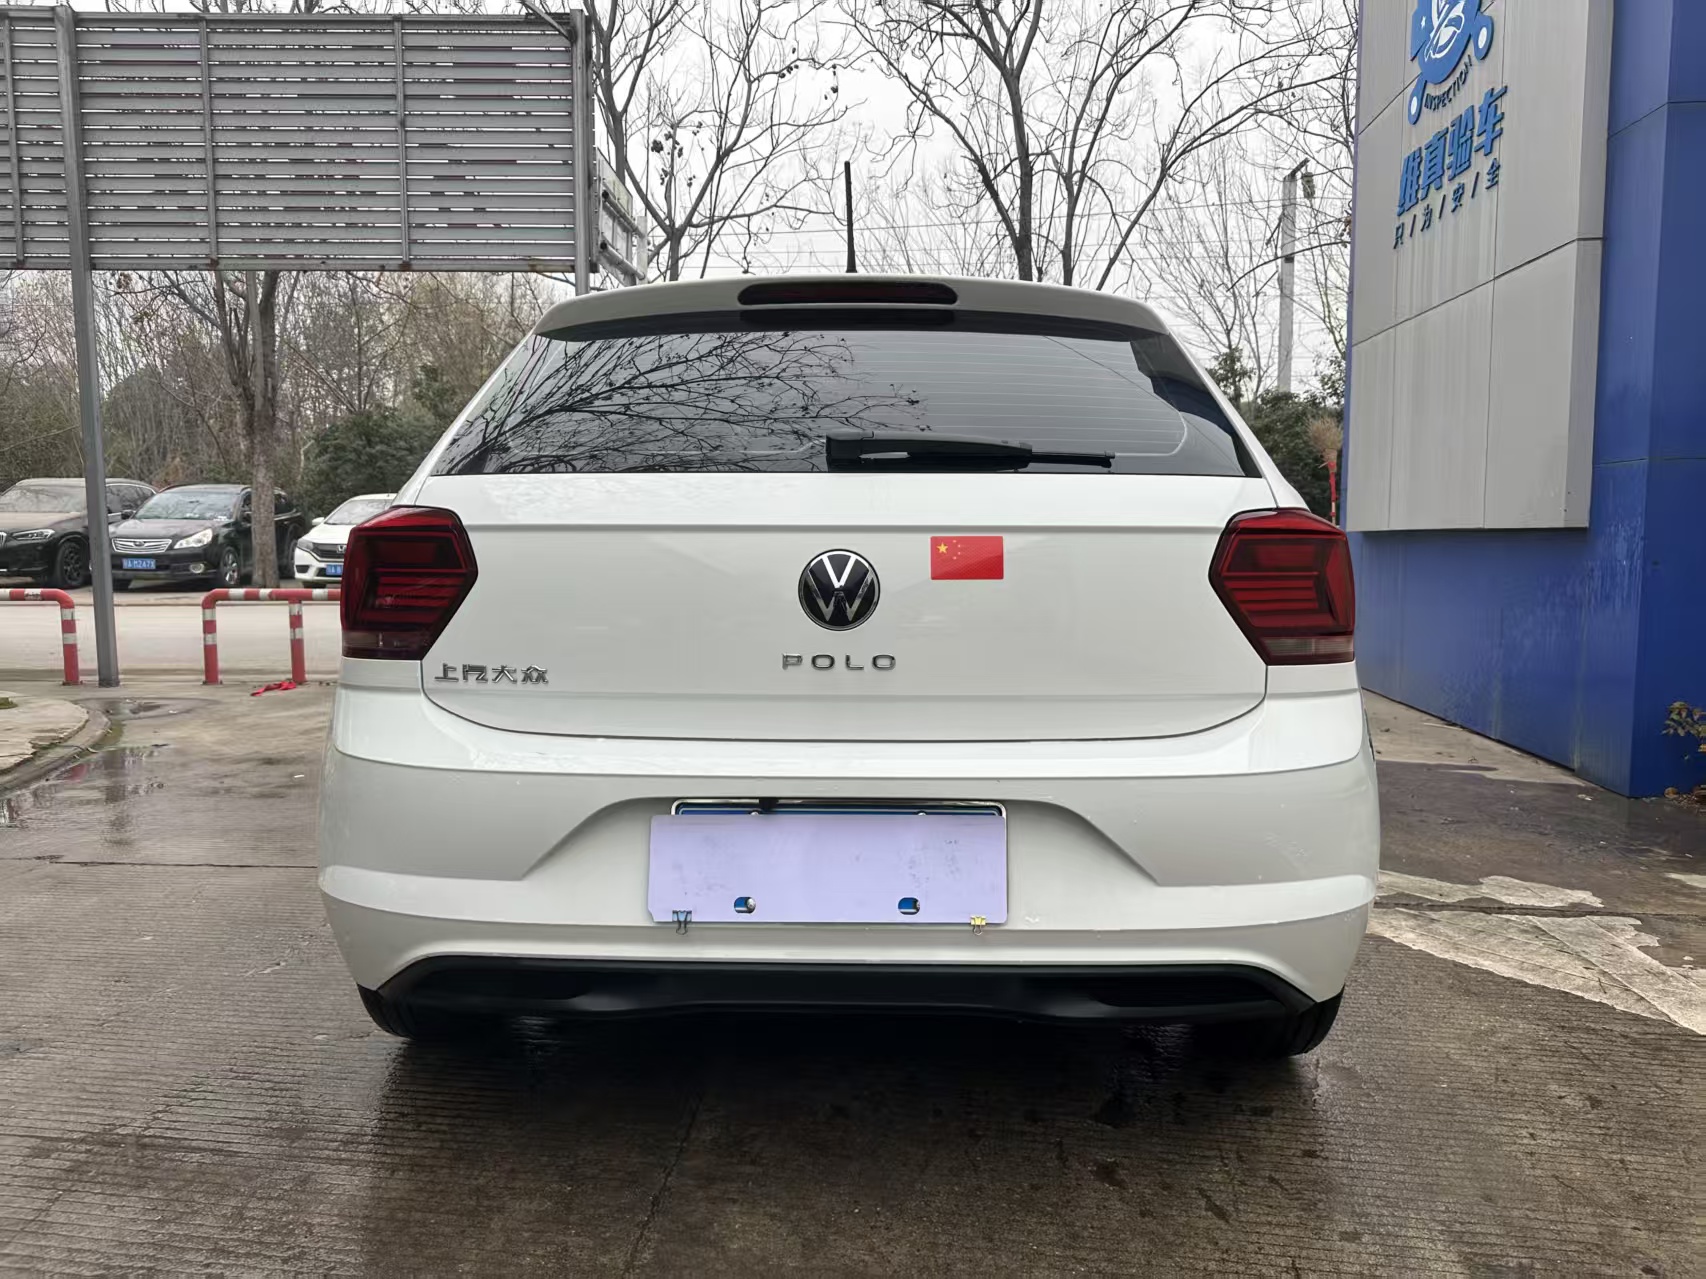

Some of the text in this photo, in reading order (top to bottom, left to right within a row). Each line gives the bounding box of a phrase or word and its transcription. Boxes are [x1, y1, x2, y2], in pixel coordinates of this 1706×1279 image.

[1424, 54, 1473, 112] INSPECTION
[434, 662, 549, 684] 上汽大众
[781, 653, 897, 671] POLO
